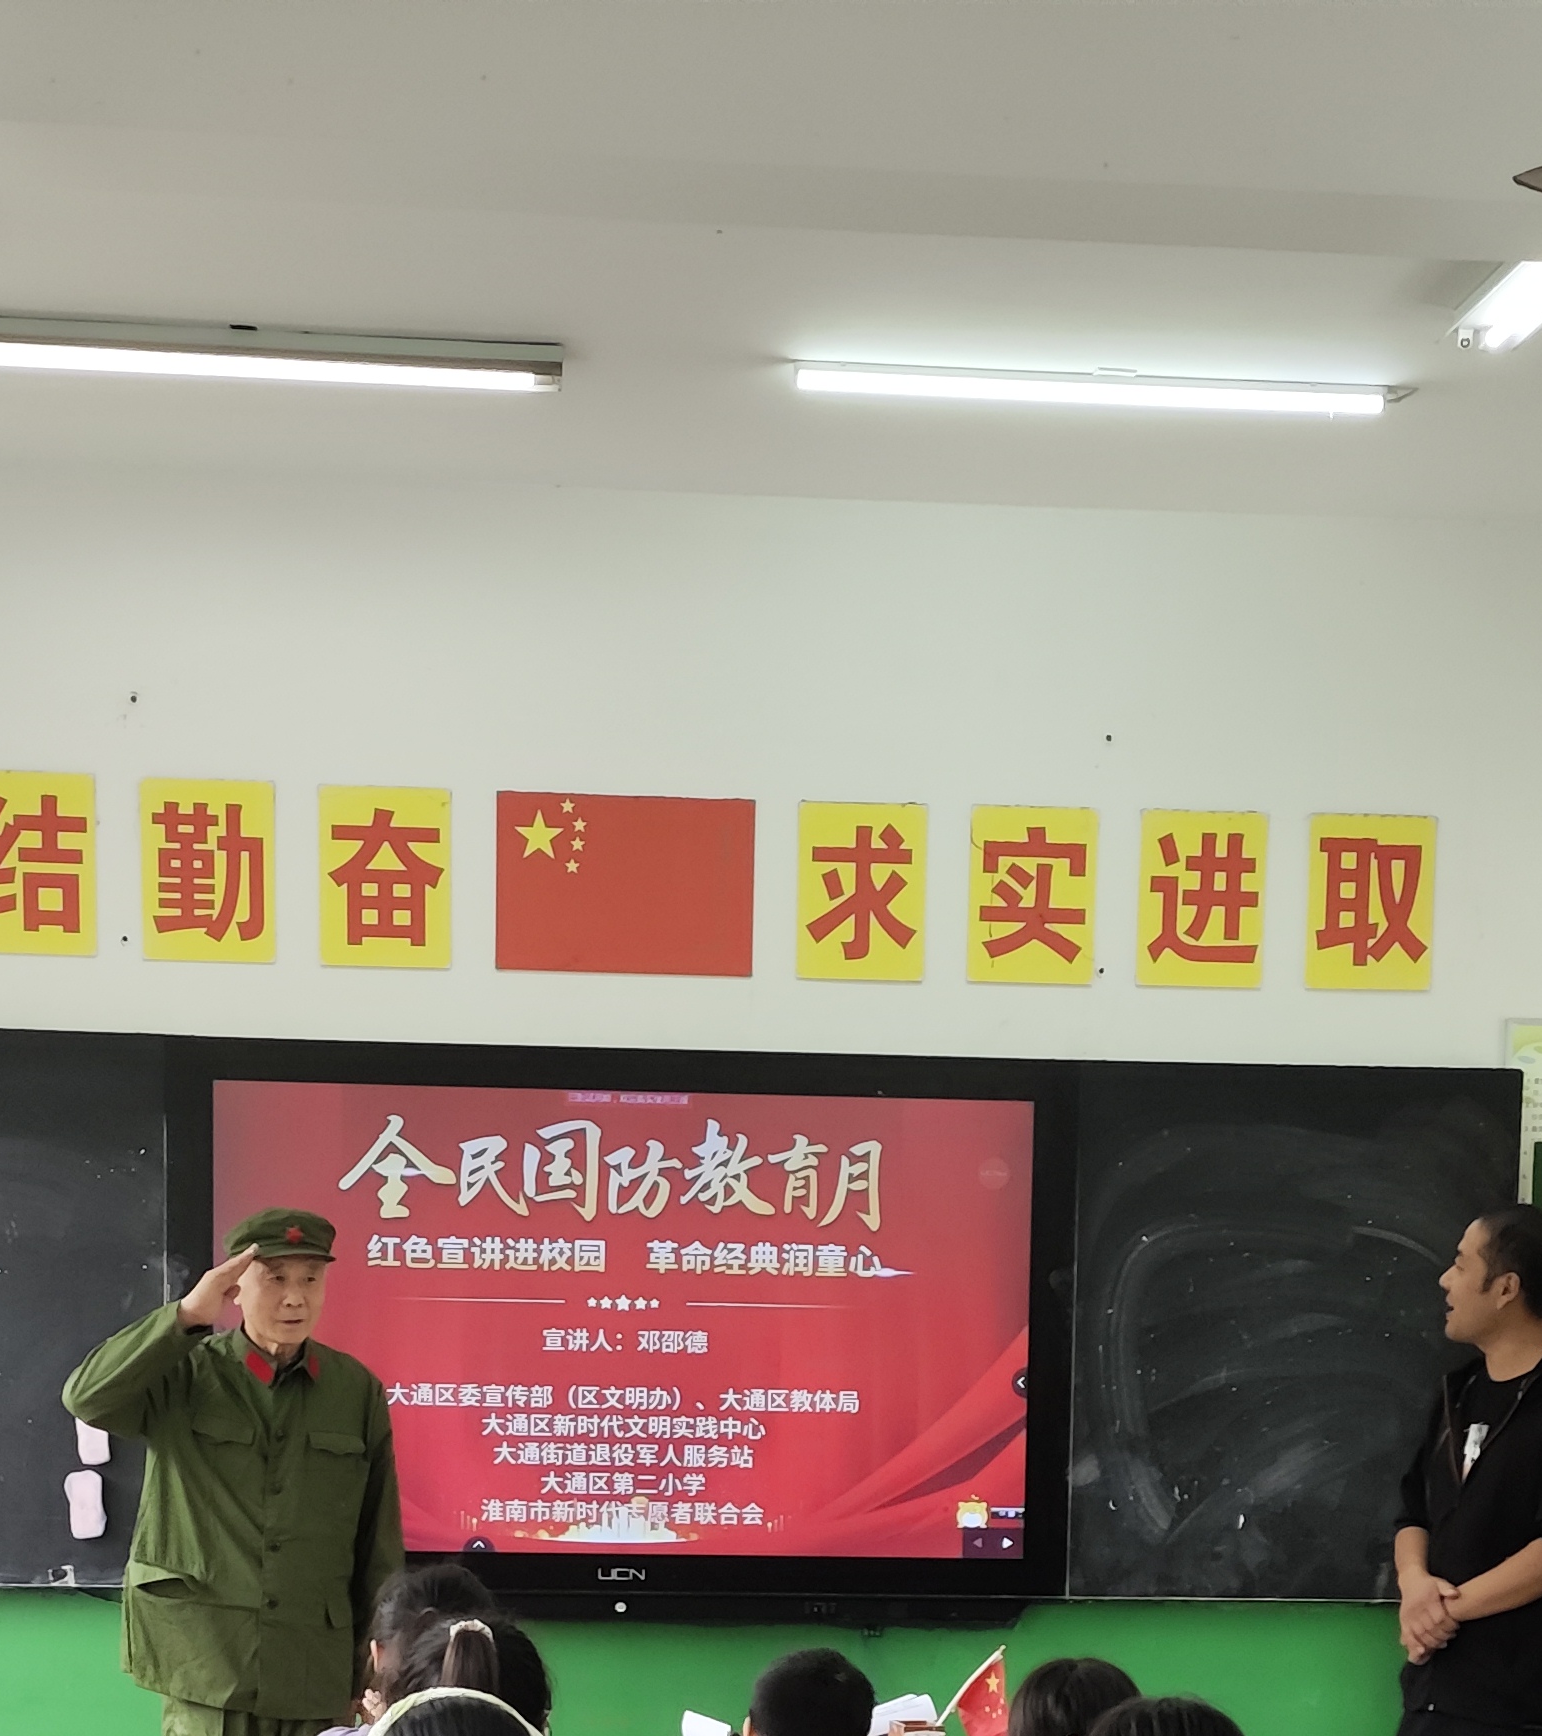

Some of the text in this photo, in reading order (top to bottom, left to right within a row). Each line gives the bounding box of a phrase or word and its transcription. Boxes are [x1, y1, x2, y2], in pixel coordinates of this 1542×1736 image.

[805, 824, 1429, 967] 求实进取
[337, 1114, 883, 1232] 全民国防教育月
[366, 1235, 882, 1278] 红色宣讲进校园 革命经典润童心
[481, 1415, 766, 1440] 大通区新时代文明实践中心
[493, 1442, 754, 1469] 大通街道退役军人服务站
[540, 1472, 706, 1496] 大通区第二小学
